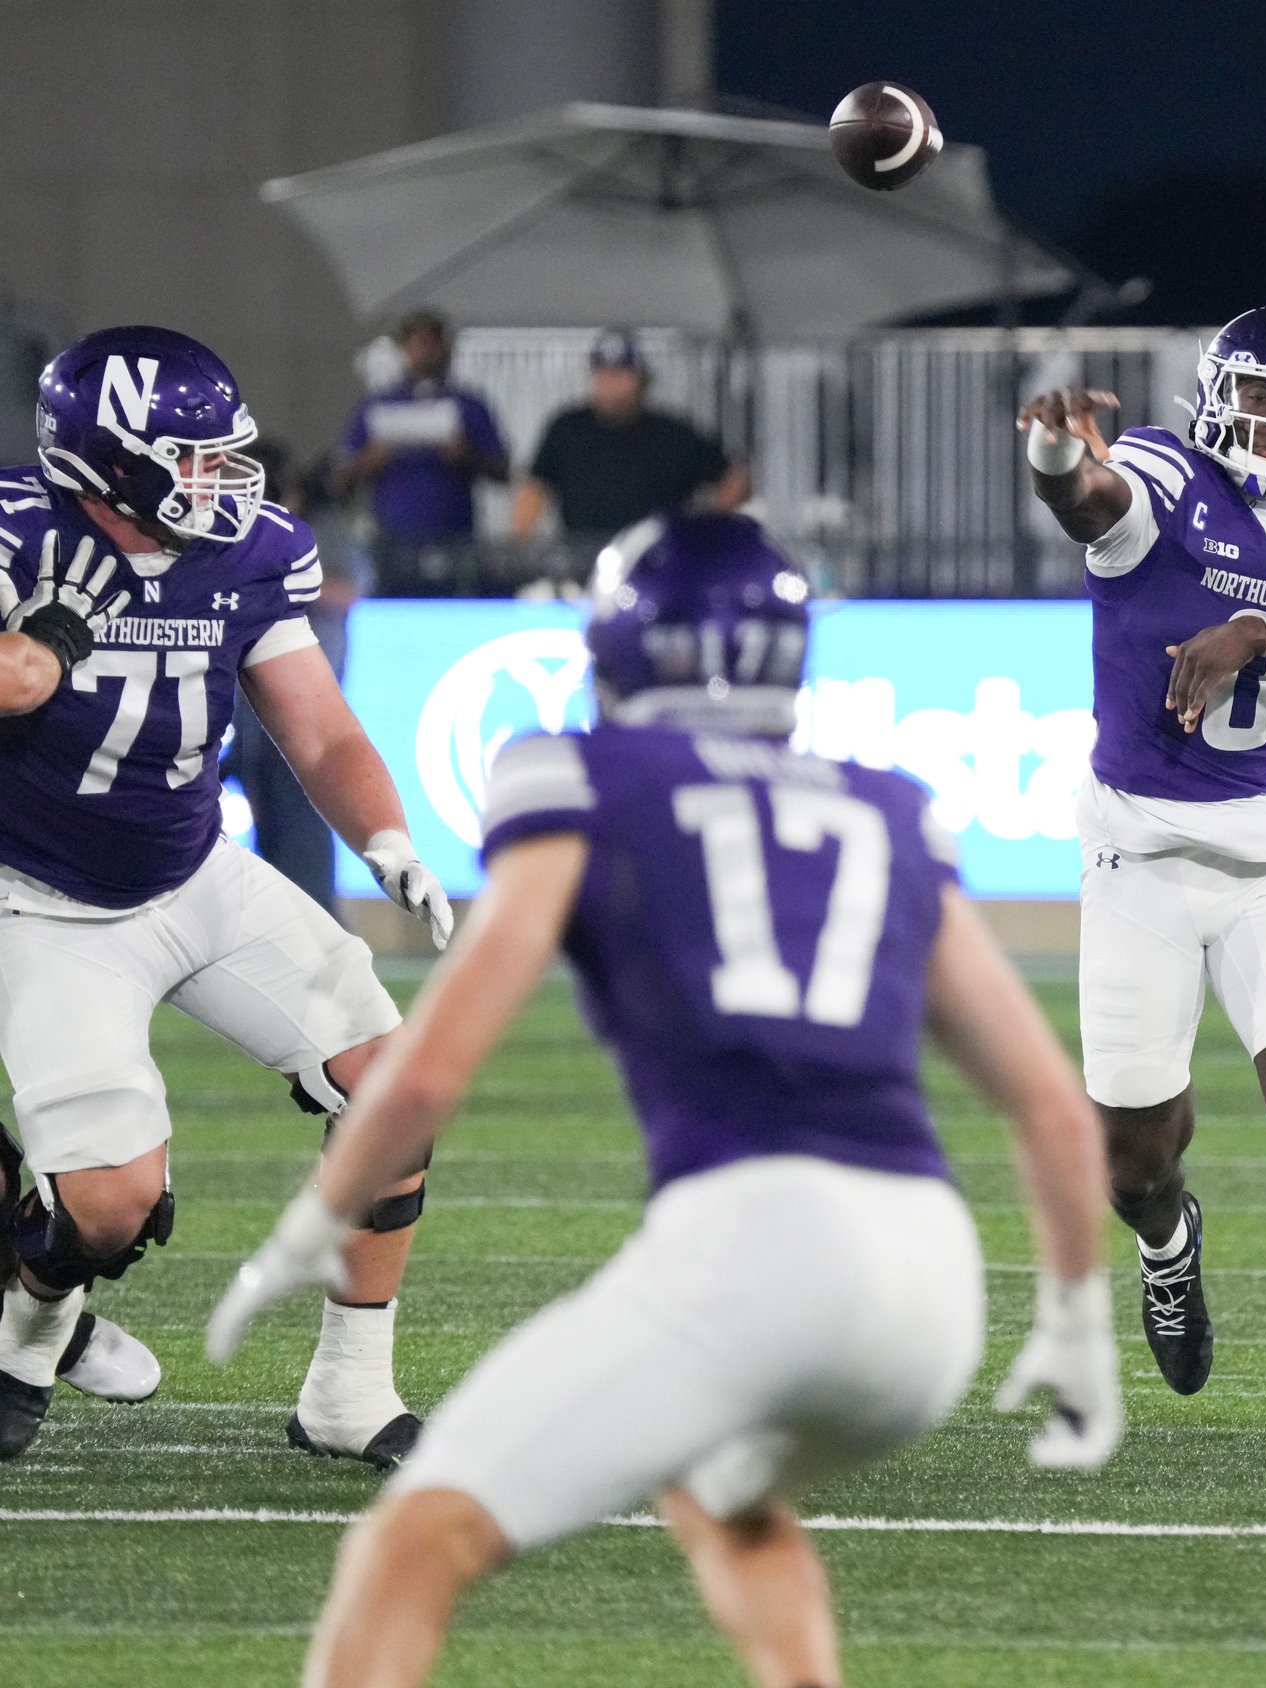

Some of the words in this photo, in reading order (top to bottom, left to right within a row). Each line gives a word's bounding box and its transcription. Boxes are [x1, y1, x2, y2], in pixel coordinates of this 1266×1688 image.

[97, 355, 158, 430] N
[1193, 501, 1208, 531] C
[144, 580, 160, 603] N
[94, 616, 225, 647] RTHWESTERN
[72, 650, 210, 795] 71
[672, 783, 890, 1028] 17
